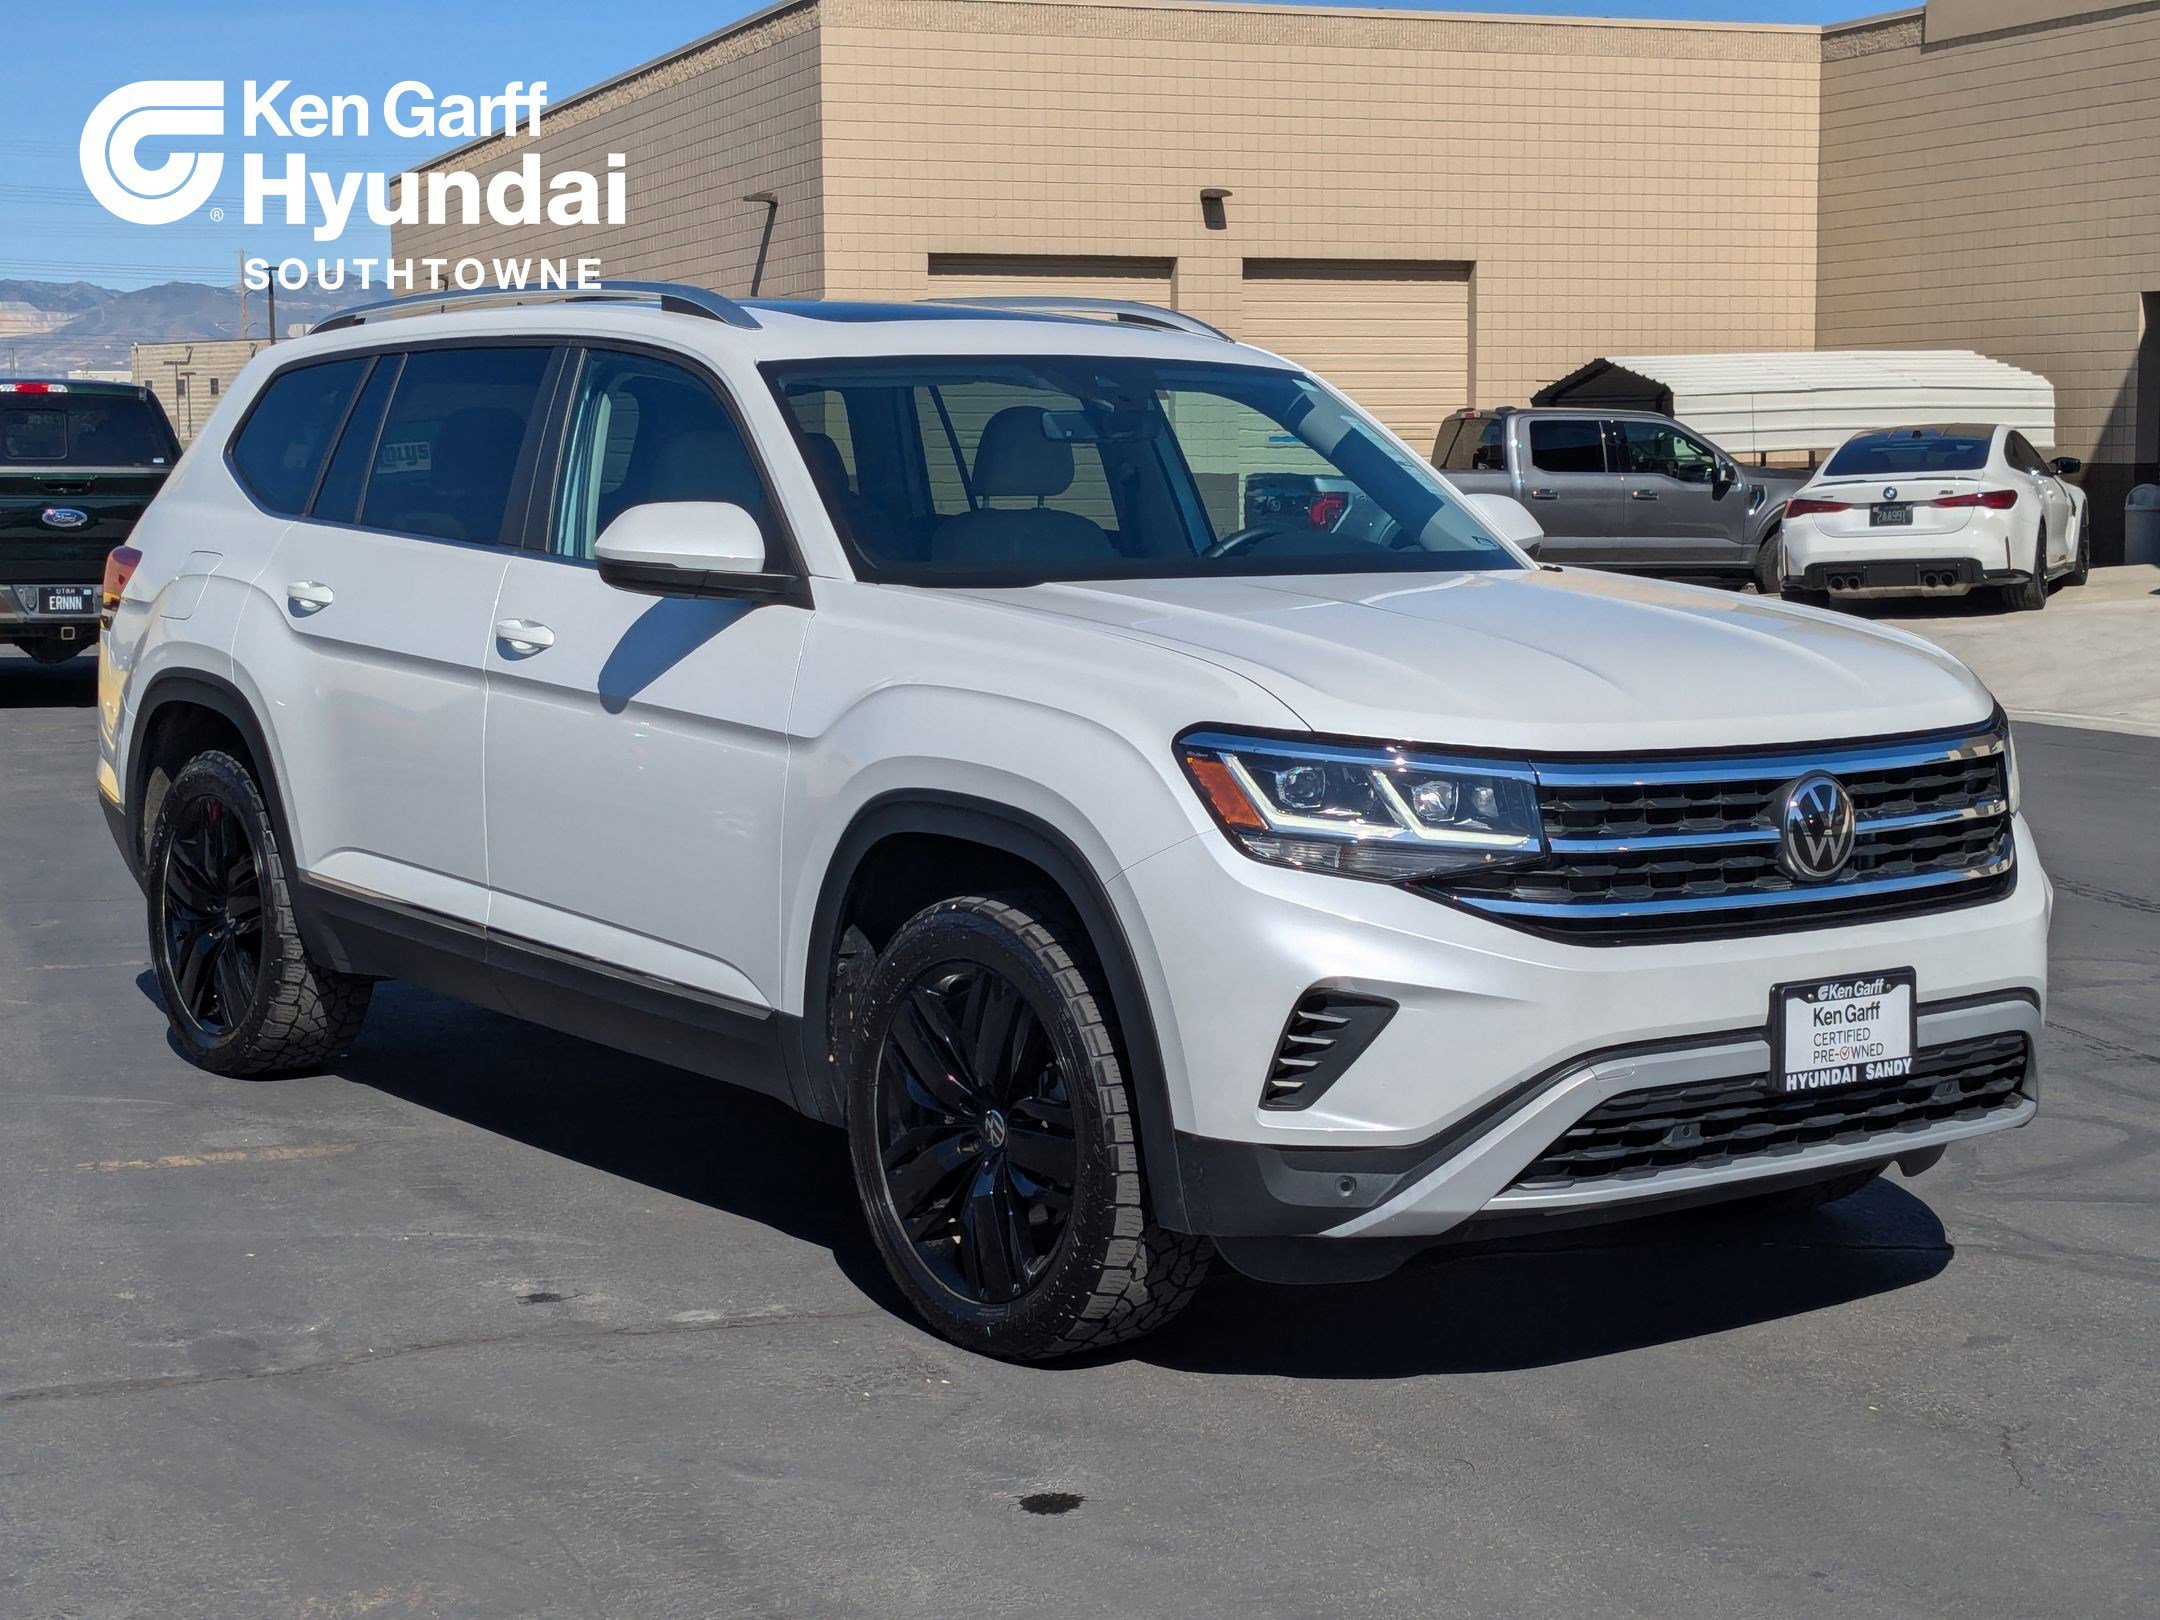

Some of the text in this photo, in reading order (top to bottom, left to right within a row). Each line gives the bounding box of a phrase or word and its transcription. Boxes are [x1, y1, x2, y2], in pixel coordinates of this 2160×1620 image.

[1828, 983, 1852, 1000] Ken
[1853, 978, 1884, 997] Garff
[1813, 1001, 1881, 1027] Ken Garff
[1813, 1027, 1871, 1047] CERTIFIED
[1786, 1057, 1913, 1092] HYUNDAI SANDY
